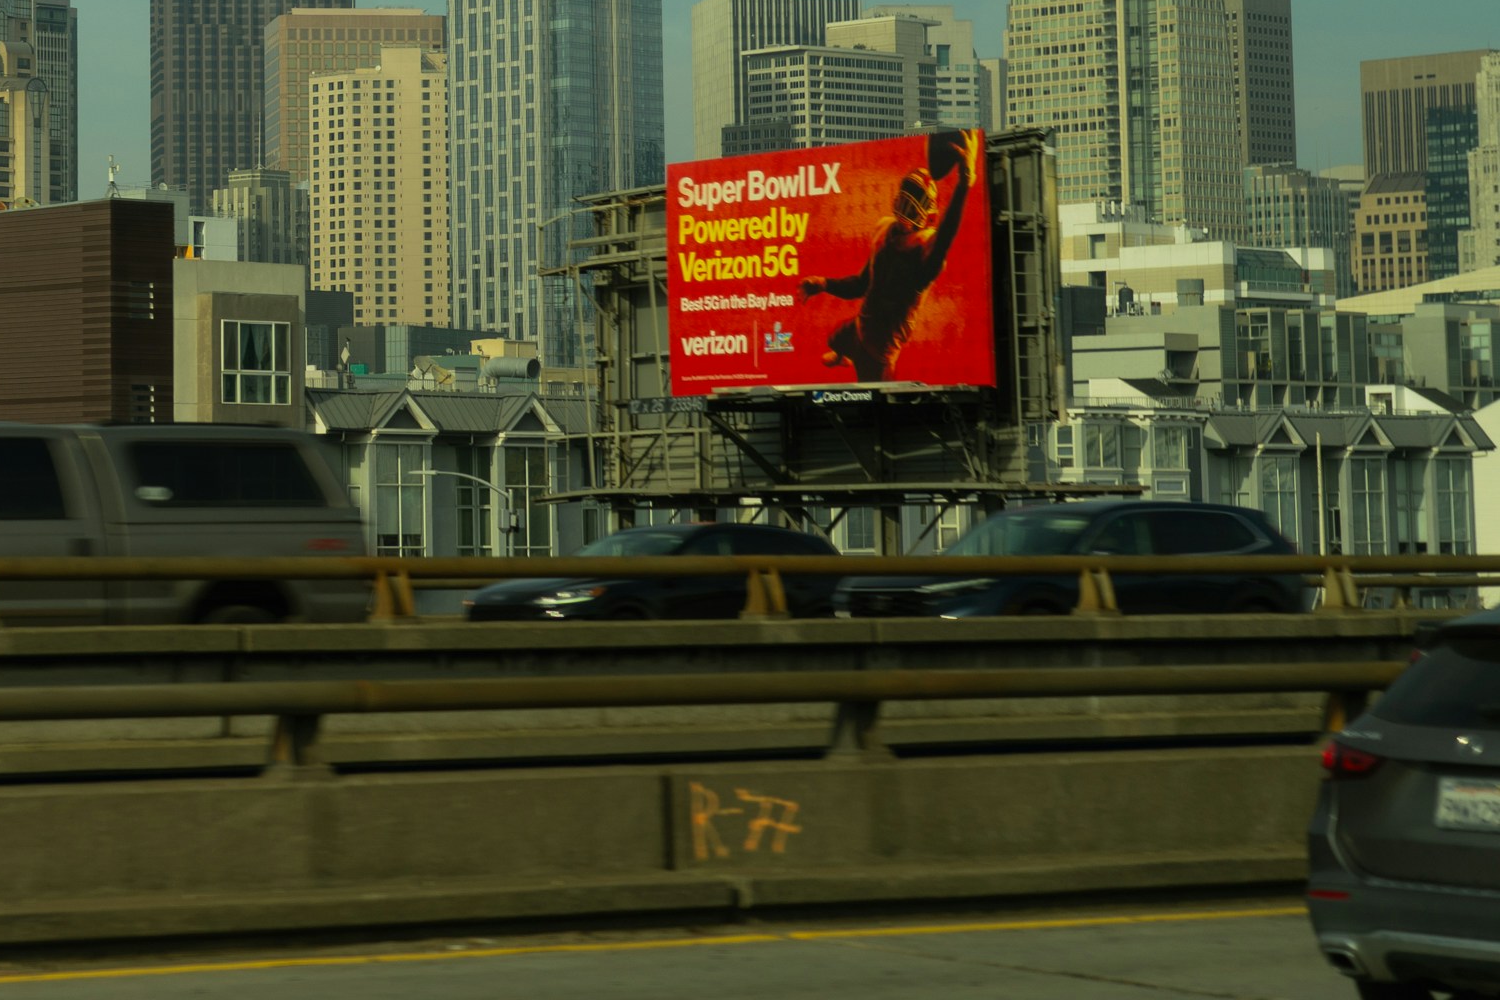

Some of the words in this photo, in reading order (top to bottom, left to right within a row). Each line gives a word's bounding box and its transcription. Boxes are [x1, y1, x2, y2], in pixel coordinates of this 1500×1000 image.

[677, 176, 746, 211] Super
[747, 166, 806, 201] Bowl
[807, 163, 841, 196] LX
[678, 207, 778, 245] Powered
[779, 206, 809, 243] by
[678, 250, 763, 282] Verizon
[763, 244, 799, 277] 5G
[680, 297, 704, 312] Best
[704, 295, 719, 310] 5G
[719, 295, 729, 309] in
[730, 294, 747, 309] the
[747, 293, 767, 311] Bay
[768, 292, 794, 307] Area
[681, 330, 747, 356] verizon
[823, 391, 842, 402] Clear
[842, 390, 873, 401] Channel
